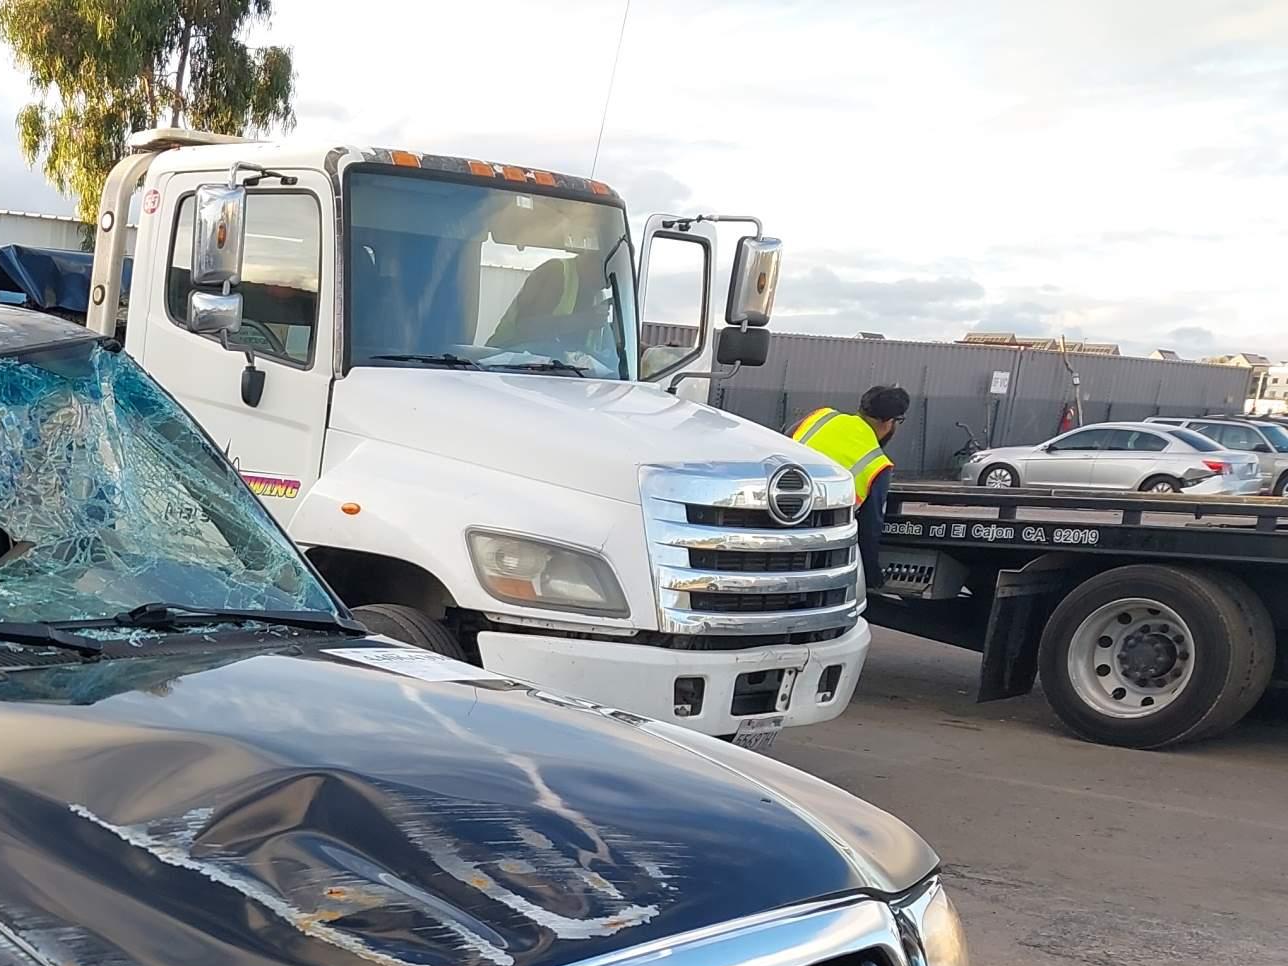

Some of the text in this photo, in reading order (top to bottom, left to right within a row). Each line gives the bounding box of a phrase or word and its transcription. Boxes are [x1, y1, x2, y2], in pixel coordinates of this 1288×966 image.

[242, 475, 301, 498] WING
[929, 524, 946, 537] rd
[951, 524, 966, 538] El
[972, 524, 1014, 542] Cajon
[1053, 529, 1100, 545] 92019
